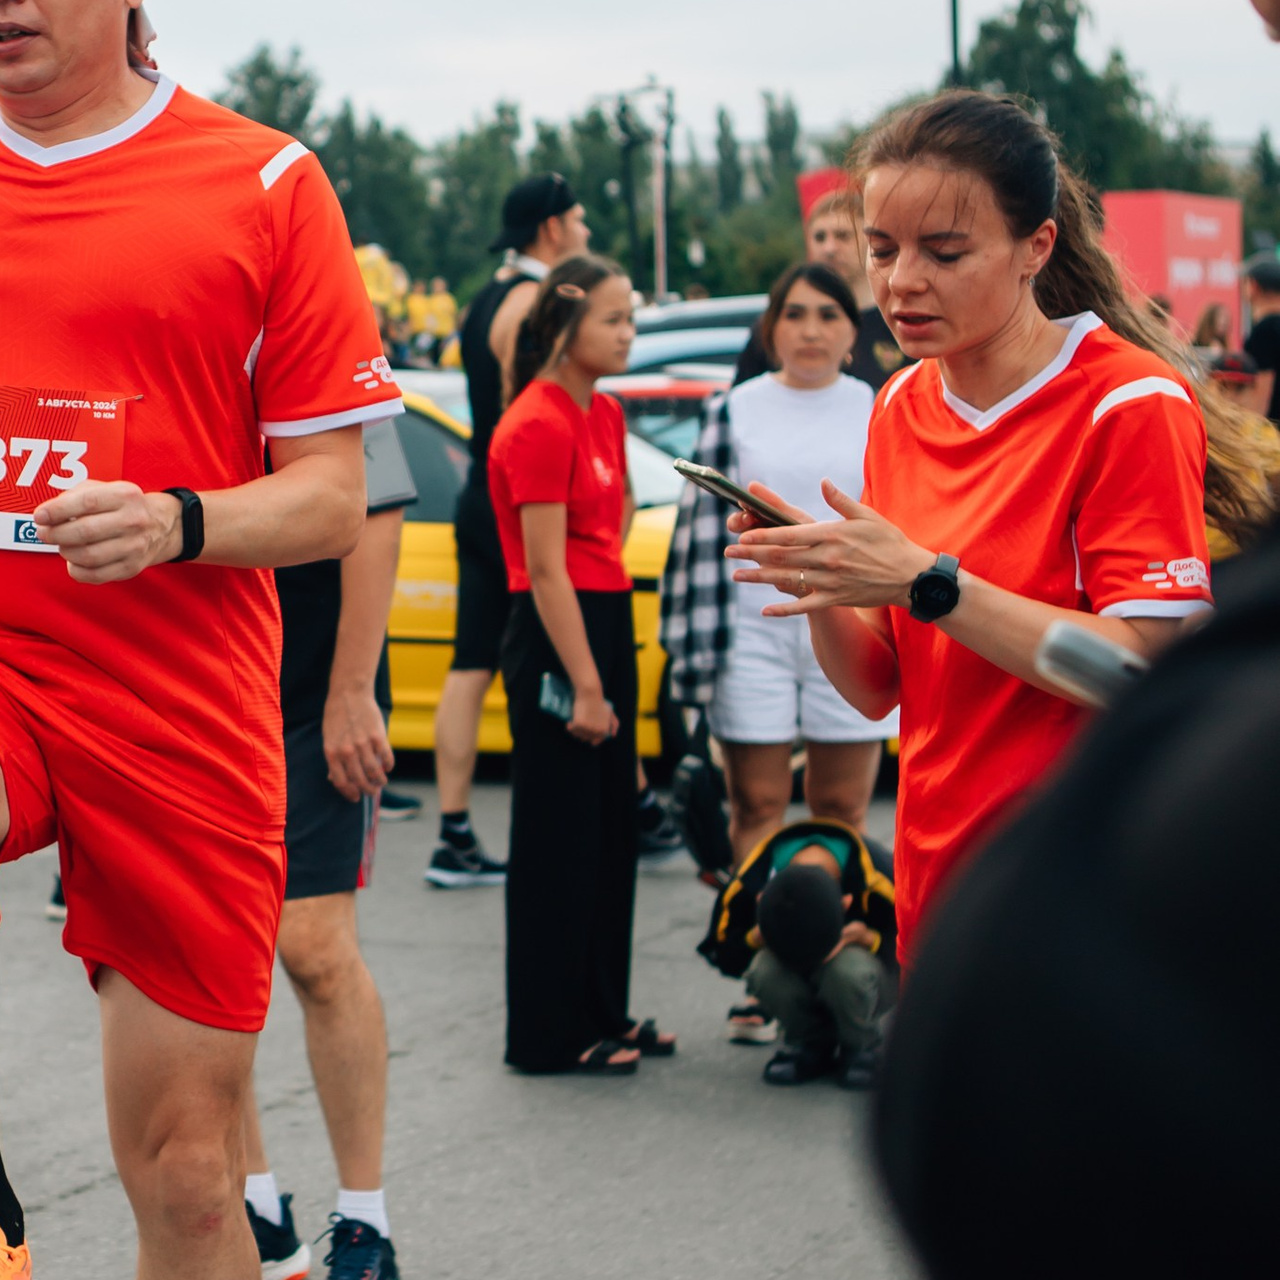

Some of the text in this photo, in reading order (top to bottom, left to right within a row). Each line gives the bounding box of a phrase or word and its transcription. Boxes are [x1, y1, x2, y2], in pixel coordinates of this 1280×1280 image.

[38, 398, 117, 411] 3 АВГУСТА 2024
